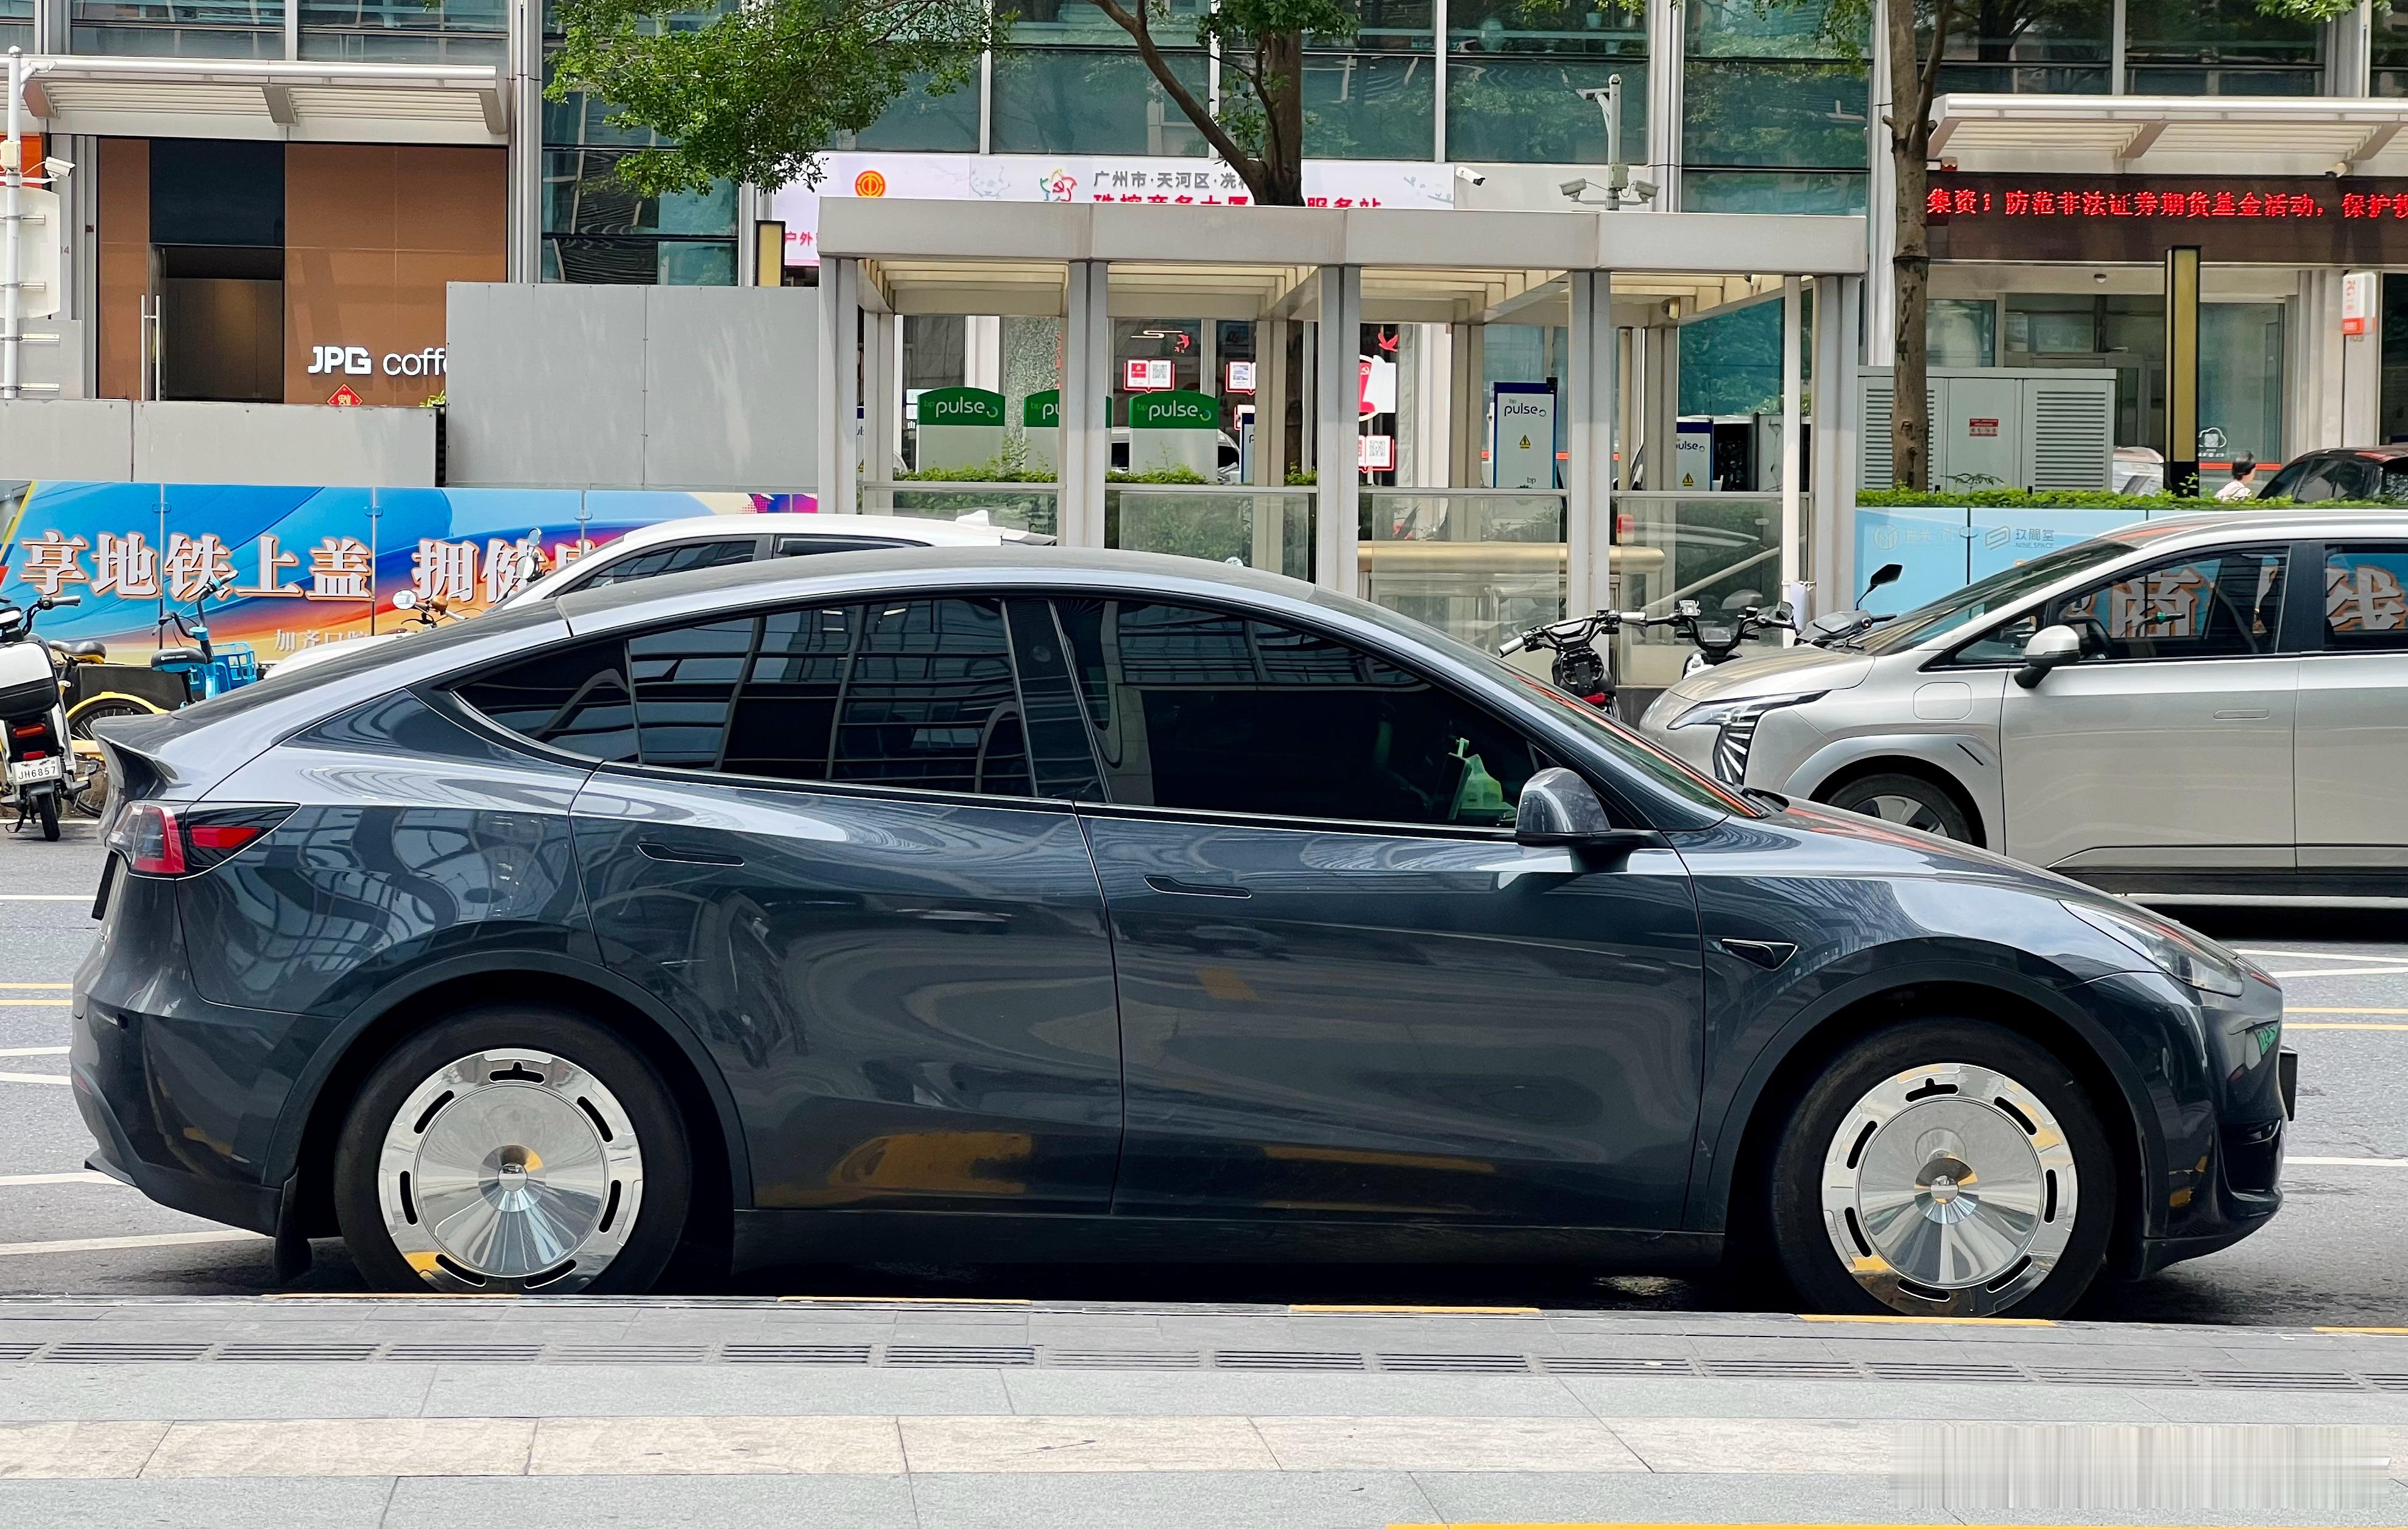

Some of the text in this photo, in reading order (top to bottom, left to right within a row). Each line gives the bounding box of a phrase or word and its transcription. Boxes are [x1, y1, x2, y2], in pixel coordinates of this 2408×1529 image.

[1093, 171, 1246, 189] 广州市·天河区·冼
[308, 346, 447, 376] JPG coff
[936, 397, 986, 418] pulse
[1149, 400, 1198, 421] pulse
[1504, 403, 1538, 417] pulse
[1527, 476, 1536, 485] bp
[21, 531, 373, 601] 享地铁上盖
[18, 766, 56, 780] JH6857
